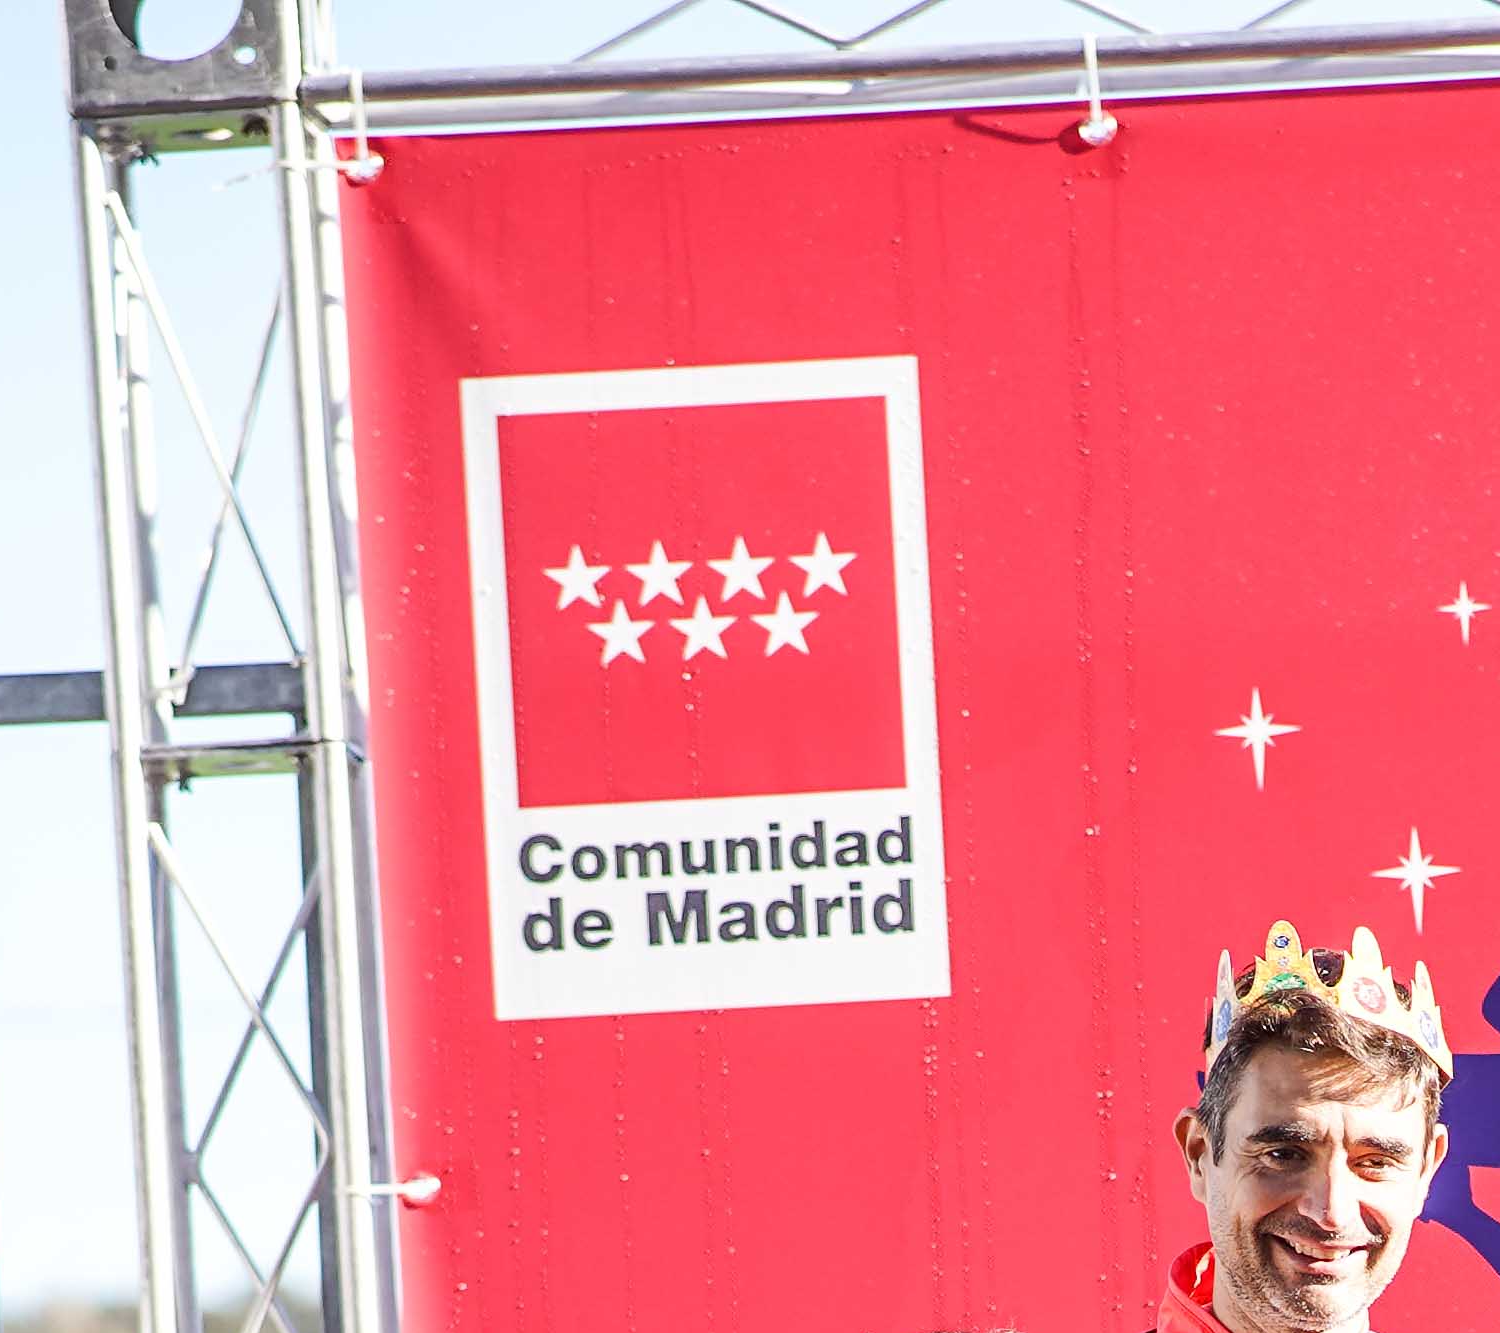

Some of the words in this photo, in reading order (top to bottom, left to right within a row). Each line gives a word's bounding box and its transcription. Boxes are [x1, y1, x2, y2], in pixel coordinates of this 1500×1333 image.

[518, 815, 914, 883] Comunidad
[522, 896, 613, 952] de
[646, 877, 916, 947] Madrid
